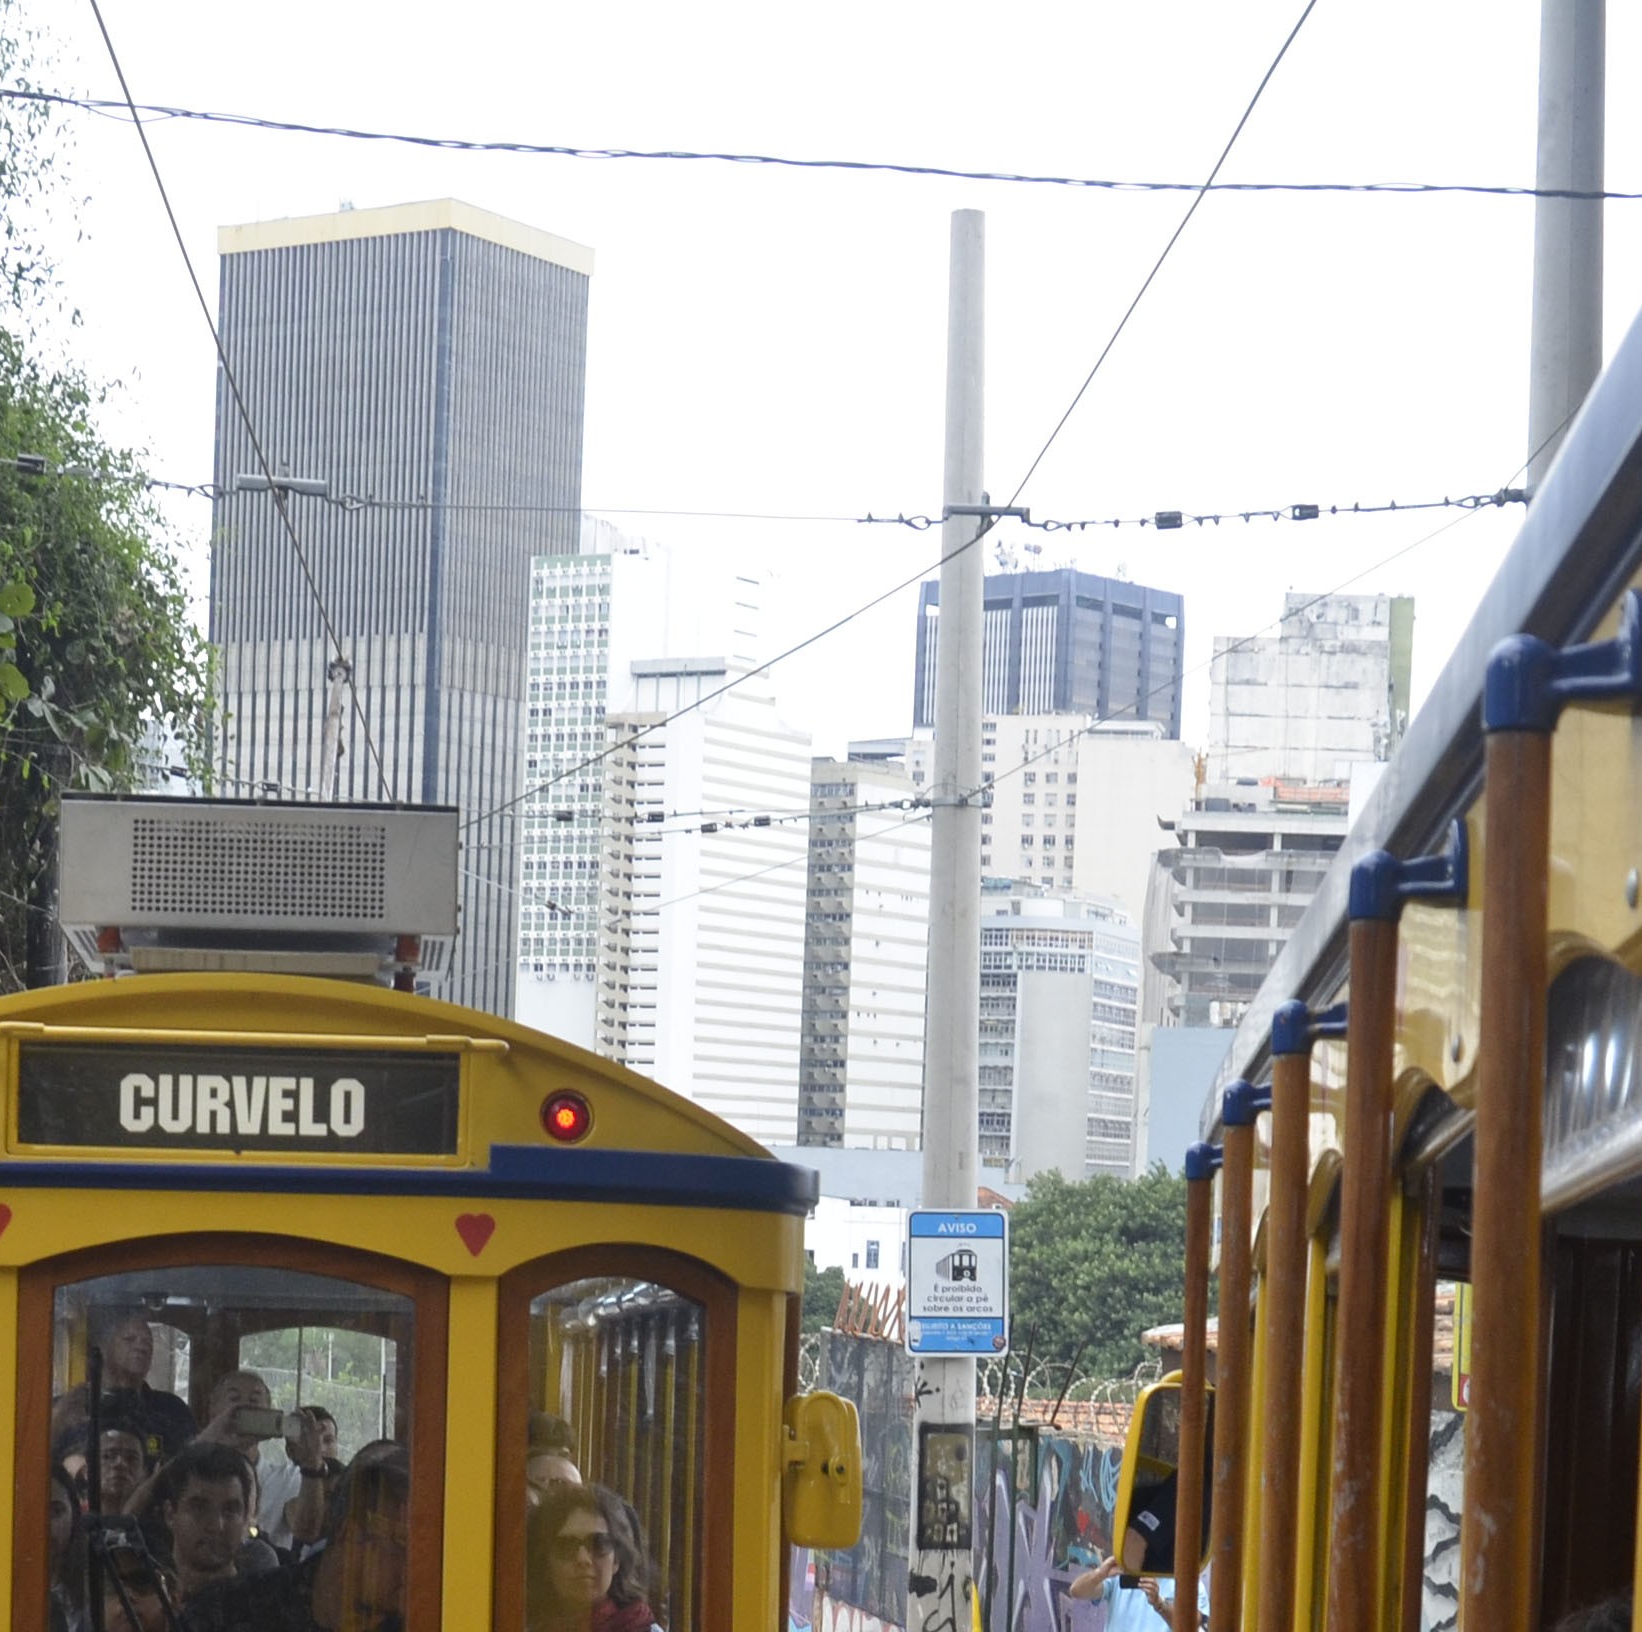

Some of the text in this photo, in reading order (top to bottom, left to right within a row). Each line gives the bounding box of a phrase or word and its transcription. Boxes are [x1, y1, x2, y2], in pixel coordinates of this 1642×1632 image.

[119, 1073, 365, 1137] CURVELO
[937, 1223, 977, 1233] AVISO
[941, 1284, 983, 1295] proibido
[927, 1295, 964, 1303] circular
[922, 1303, 950, 1312] sobre
